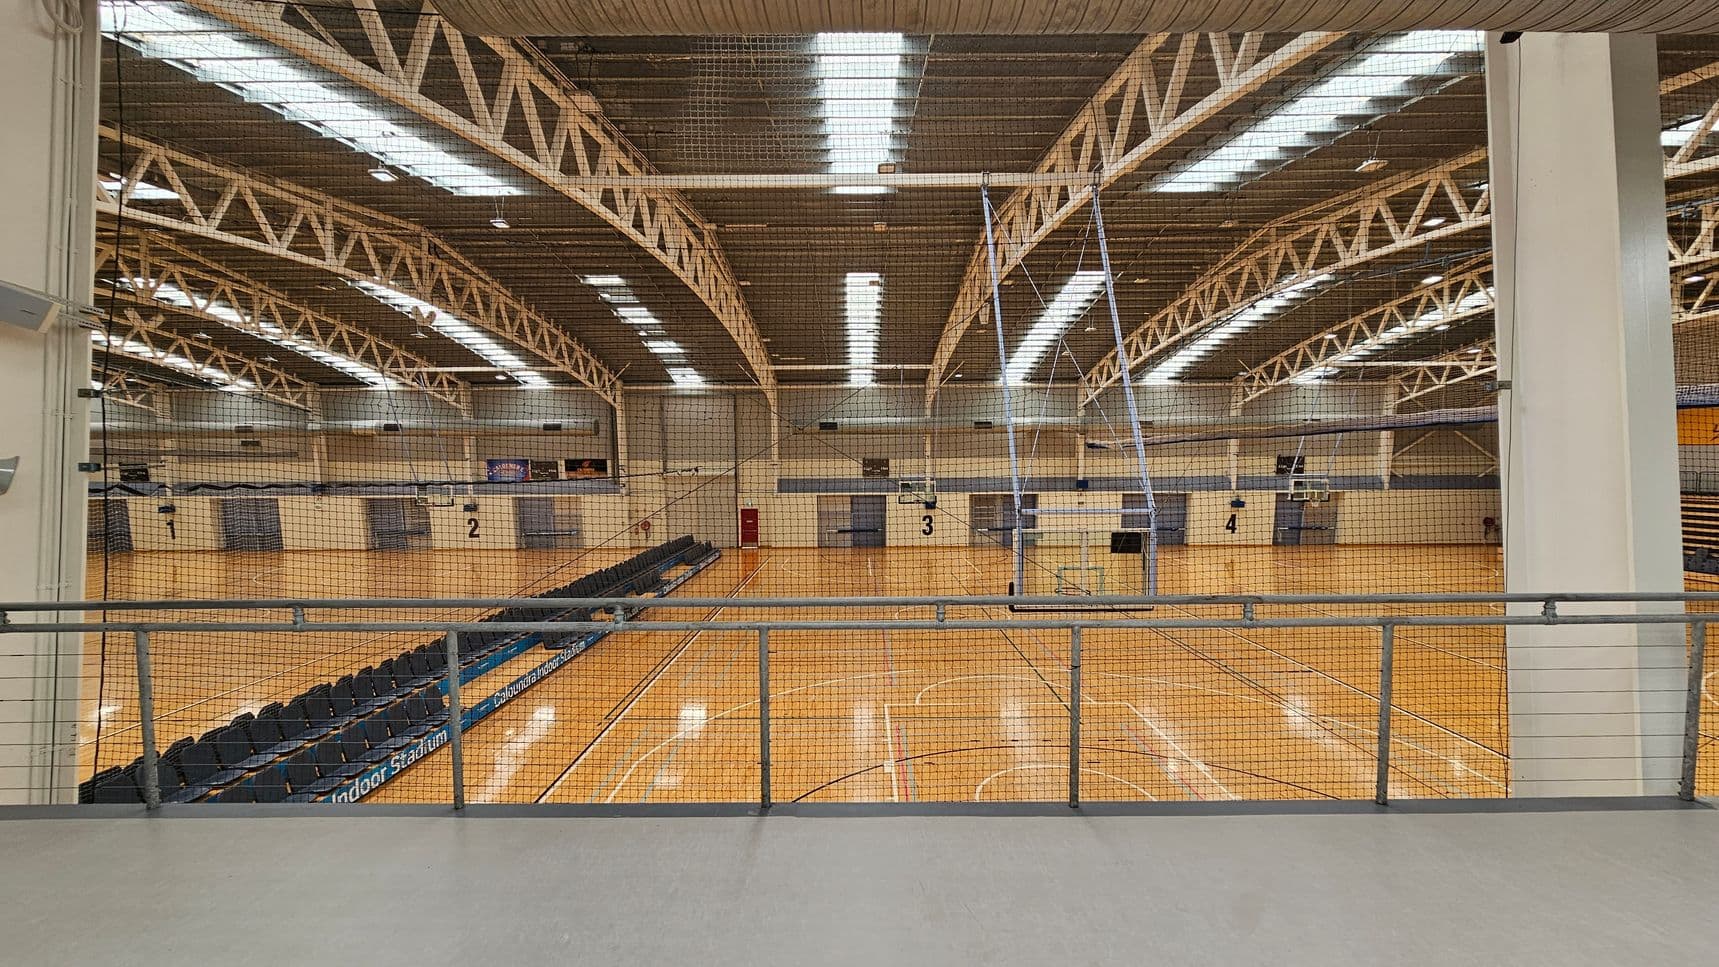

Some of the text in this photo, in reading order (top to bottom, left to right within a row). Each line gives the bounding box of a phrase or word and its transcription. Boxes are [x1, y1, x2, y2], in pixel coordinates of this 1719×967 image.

[166, 519, 176, 539] 1
[468, 518, 480, 538] 2
[922, 515, 934, 536] 3
[1226, 514, 1237, 534] 4
[494, 672, 537, 708] Caloundra
[536, 656, 560, 680] Indoor
[331, 729, 447, 803] Indoor Stadium
